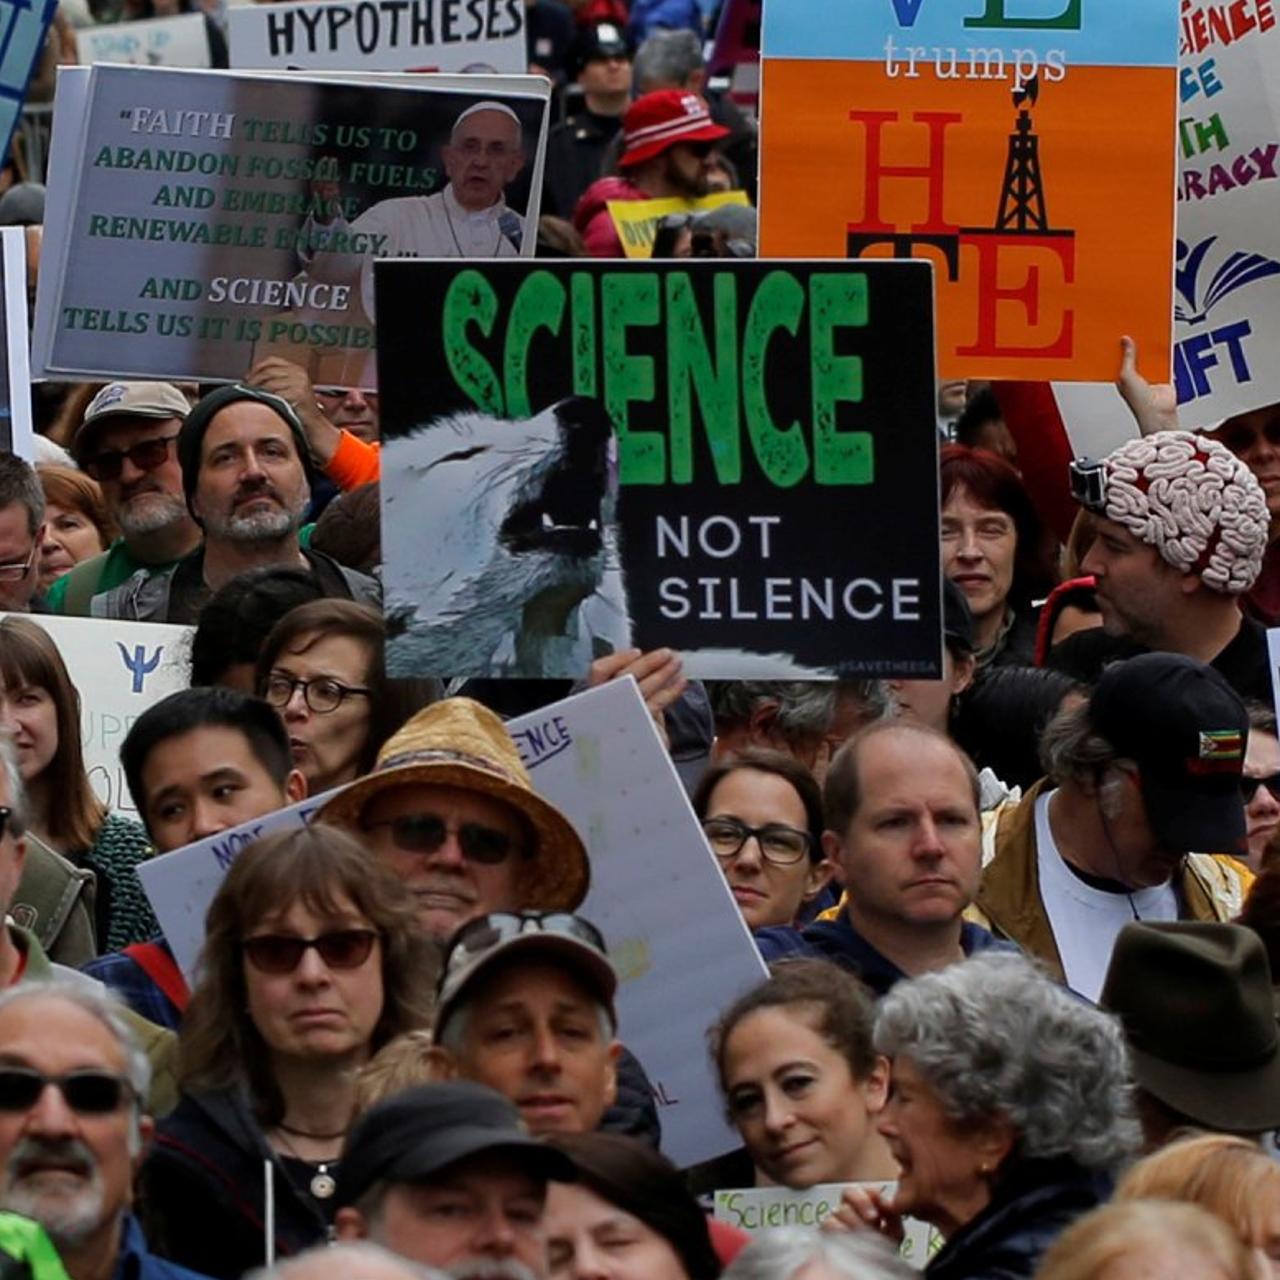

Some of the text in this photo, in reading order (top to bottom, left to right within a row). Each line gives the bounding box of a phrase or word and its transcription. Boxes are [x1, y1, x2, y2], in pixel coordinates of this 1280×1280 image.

[883, 32, 1067, 92] trumps
[243, 118, 328, 145] TELLS
[335, 124, 372, 147] US
[379, 126, 417, 152] TO
[93, 145, 439, 189] ABANDON FOSSIL FUELS
[1178, 143, 1280, 202] RACY
[152, 184, 362, 218] AND EMBRACE
[87, 213, 267, 248] RENEWABLE
[139, 276, 352, 312] AND SCIENCE
[62, 306, 375, 349] TELLS US IT IS POSSIB
[442, 270, 875, 487] SCIENCE
[655, 514, 782, 561] NOT
[659, 574, 921, 621] SILENCE
